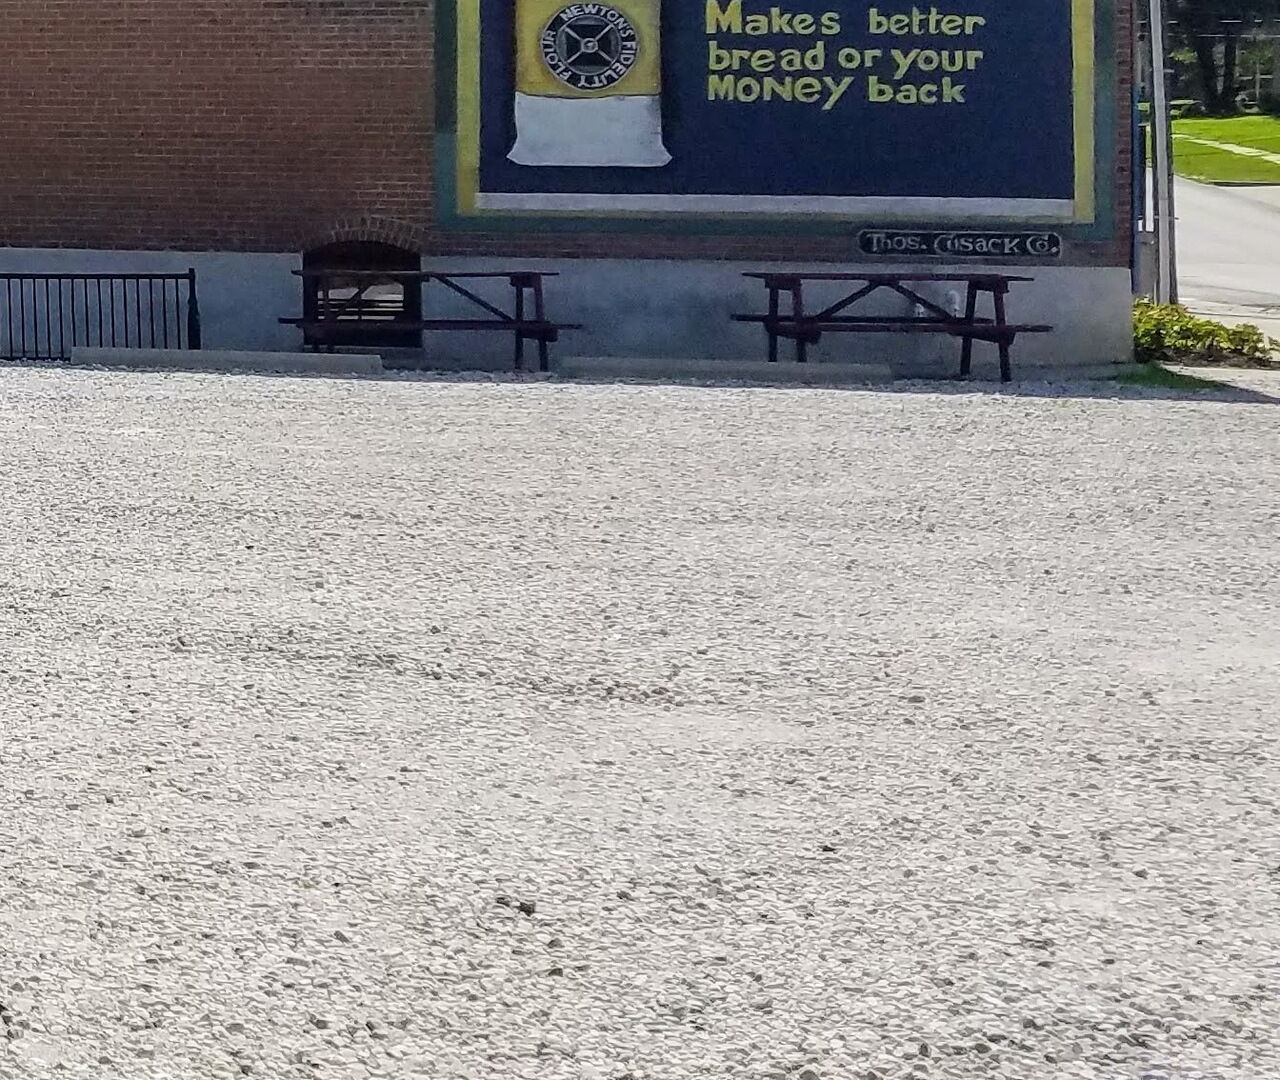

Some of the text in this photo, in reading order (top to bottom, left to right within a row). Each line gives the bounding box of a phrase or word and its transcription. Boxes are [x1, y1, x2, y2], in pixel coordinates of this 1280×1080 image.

[868, 5, 987, 36] better
[542, 30, 573, 81] FLOUR
[578, 41, 637, 89] FIDELITY
[707, 40, 985, 81] bread or your
[867, 75, 967, 105] back
